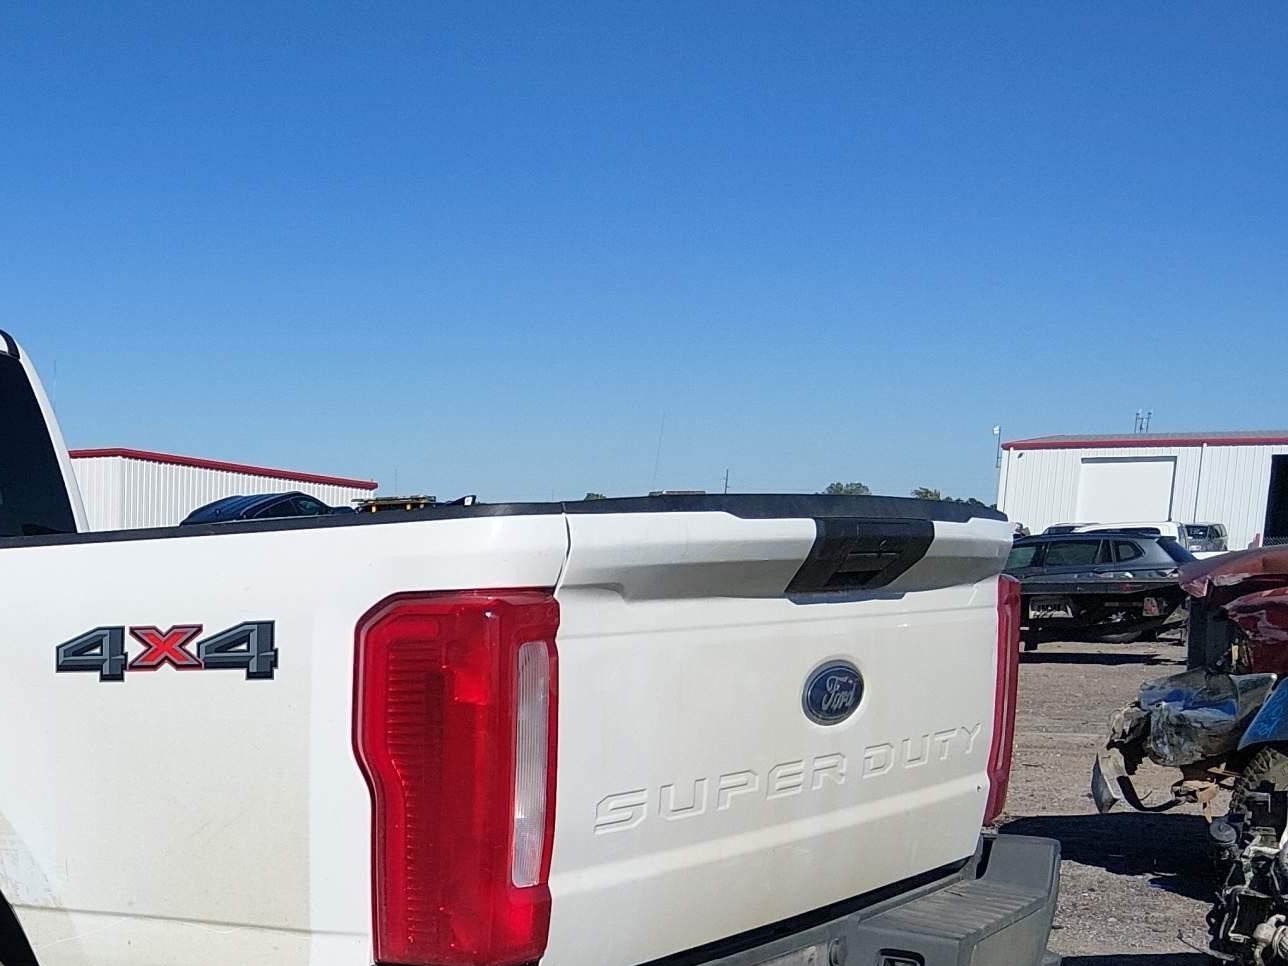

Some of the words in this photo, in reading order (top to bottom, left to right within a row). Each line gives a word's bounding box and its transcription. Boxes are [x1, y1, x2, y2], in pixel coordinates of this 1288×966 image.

[822, 675, 858, 711] Ford
[594, 751, 847, 835] SUPER
[862, 721, 983, 780] DUTY
